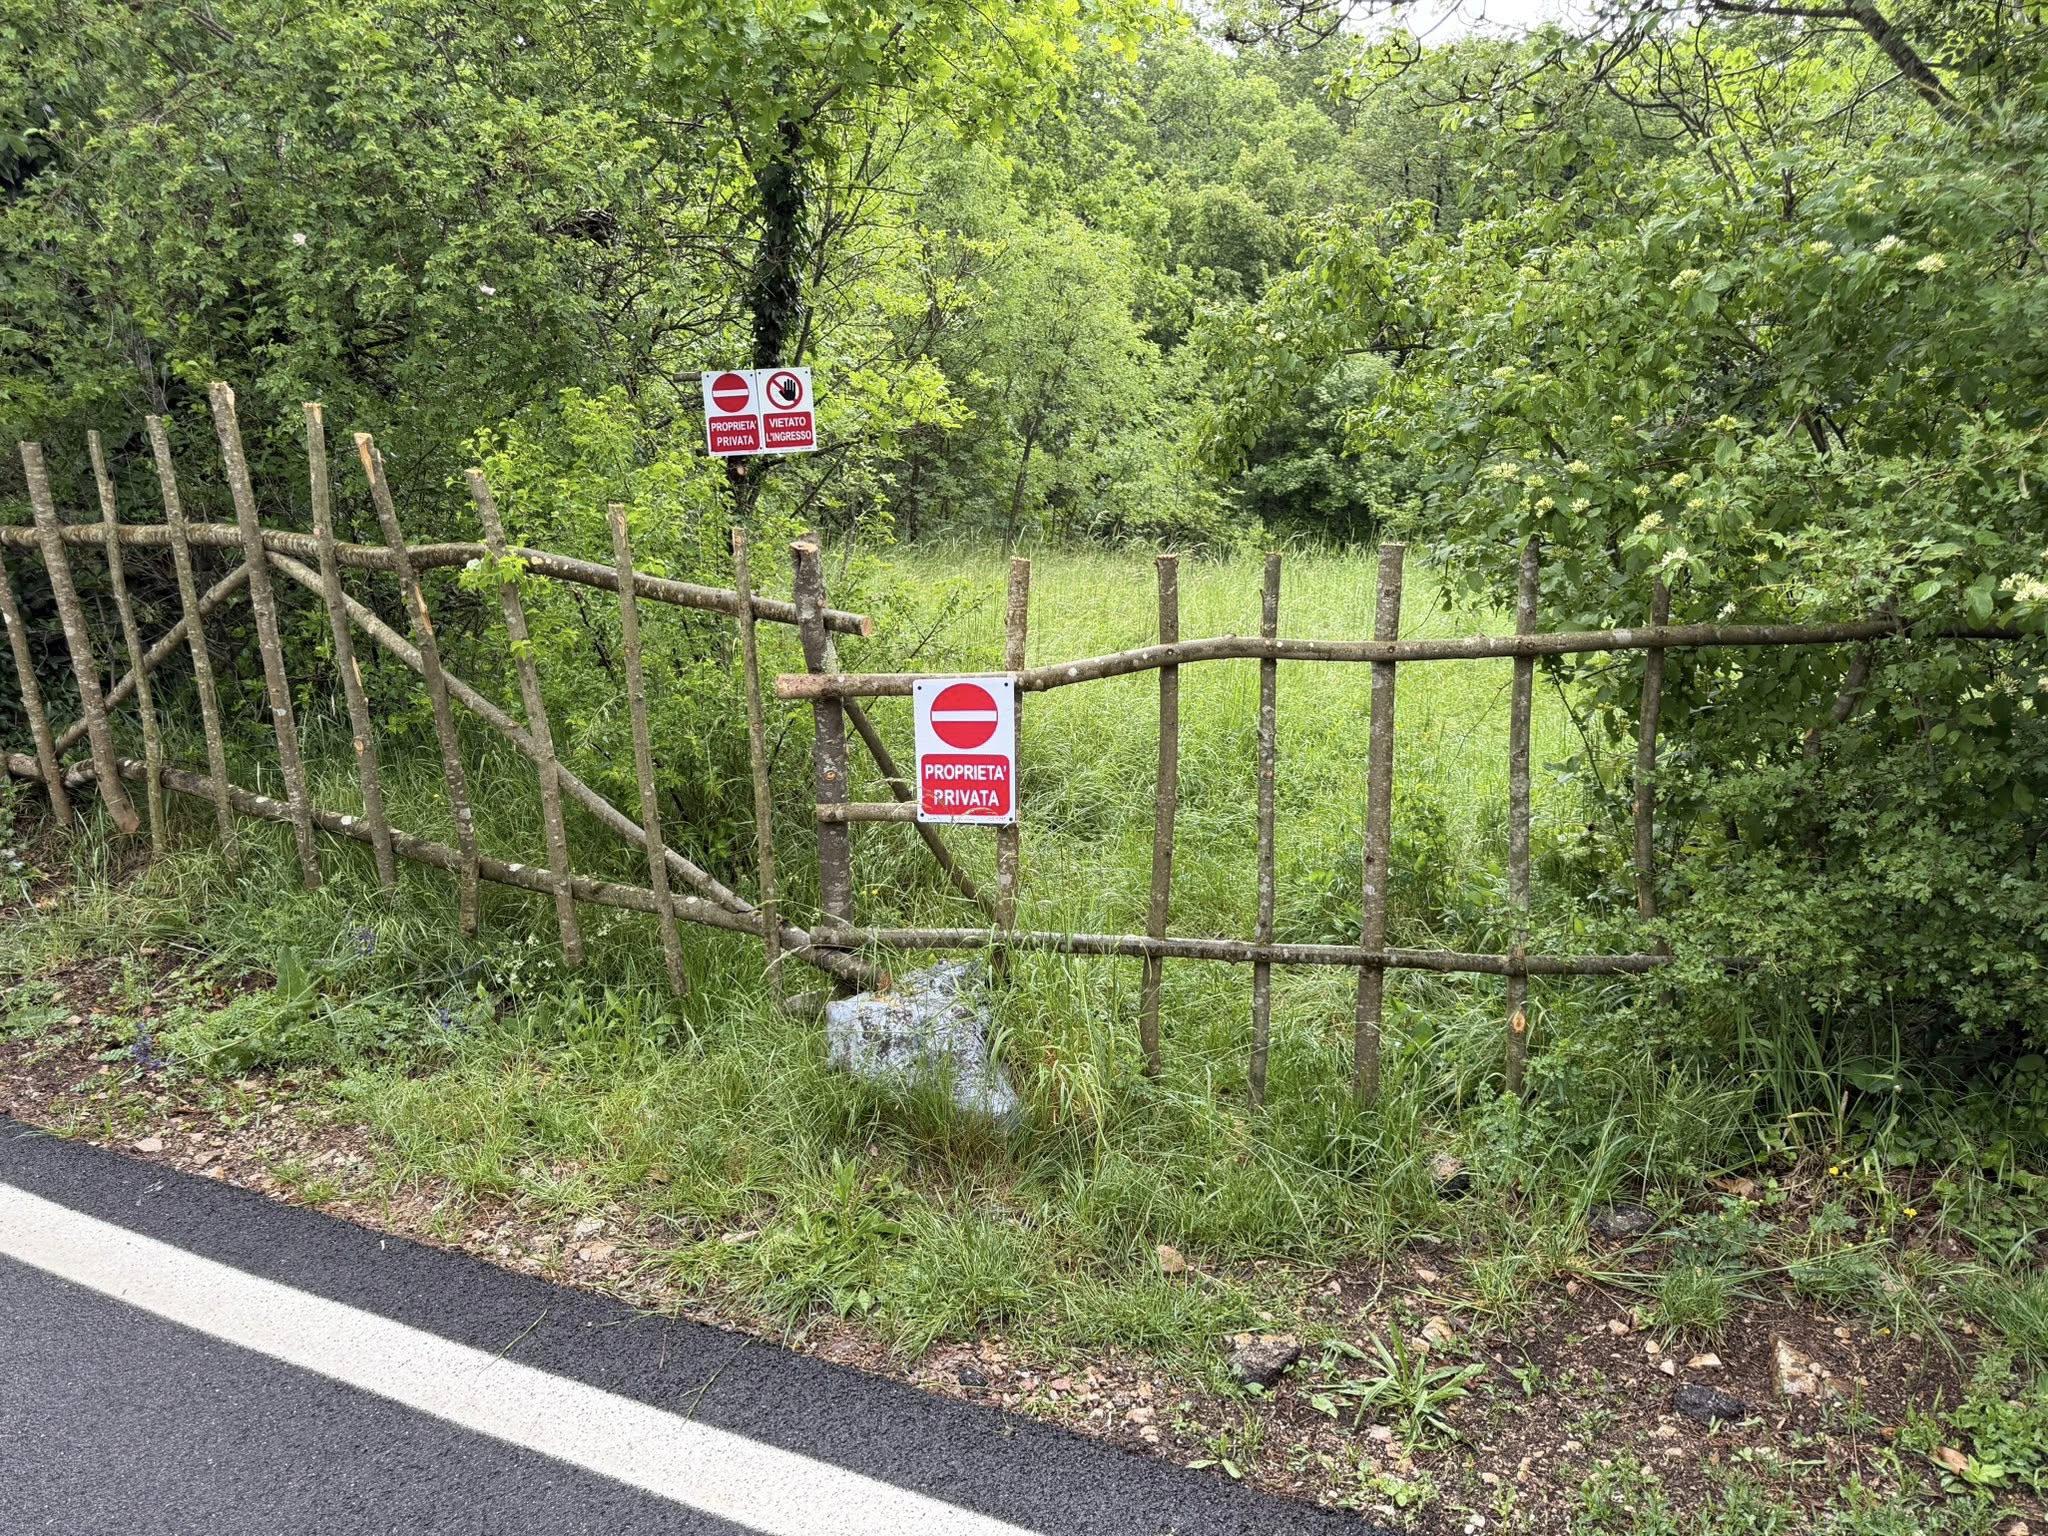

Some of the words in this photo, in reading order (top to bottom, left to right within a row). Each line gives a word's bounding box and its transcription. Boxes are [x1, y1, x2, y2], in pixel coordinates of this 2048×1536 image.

[711, 420, 757, 432] PROPRIETA'
[769, 417, 806, 428] VIETATO
[717, 436, 754, 447] PRIVATA
[766, 430, 812, 442] L'INGRESSO
[925, 764, 1007, 780] PROPRIETA'
[933, 789, 1000, 806] PRIVATA
